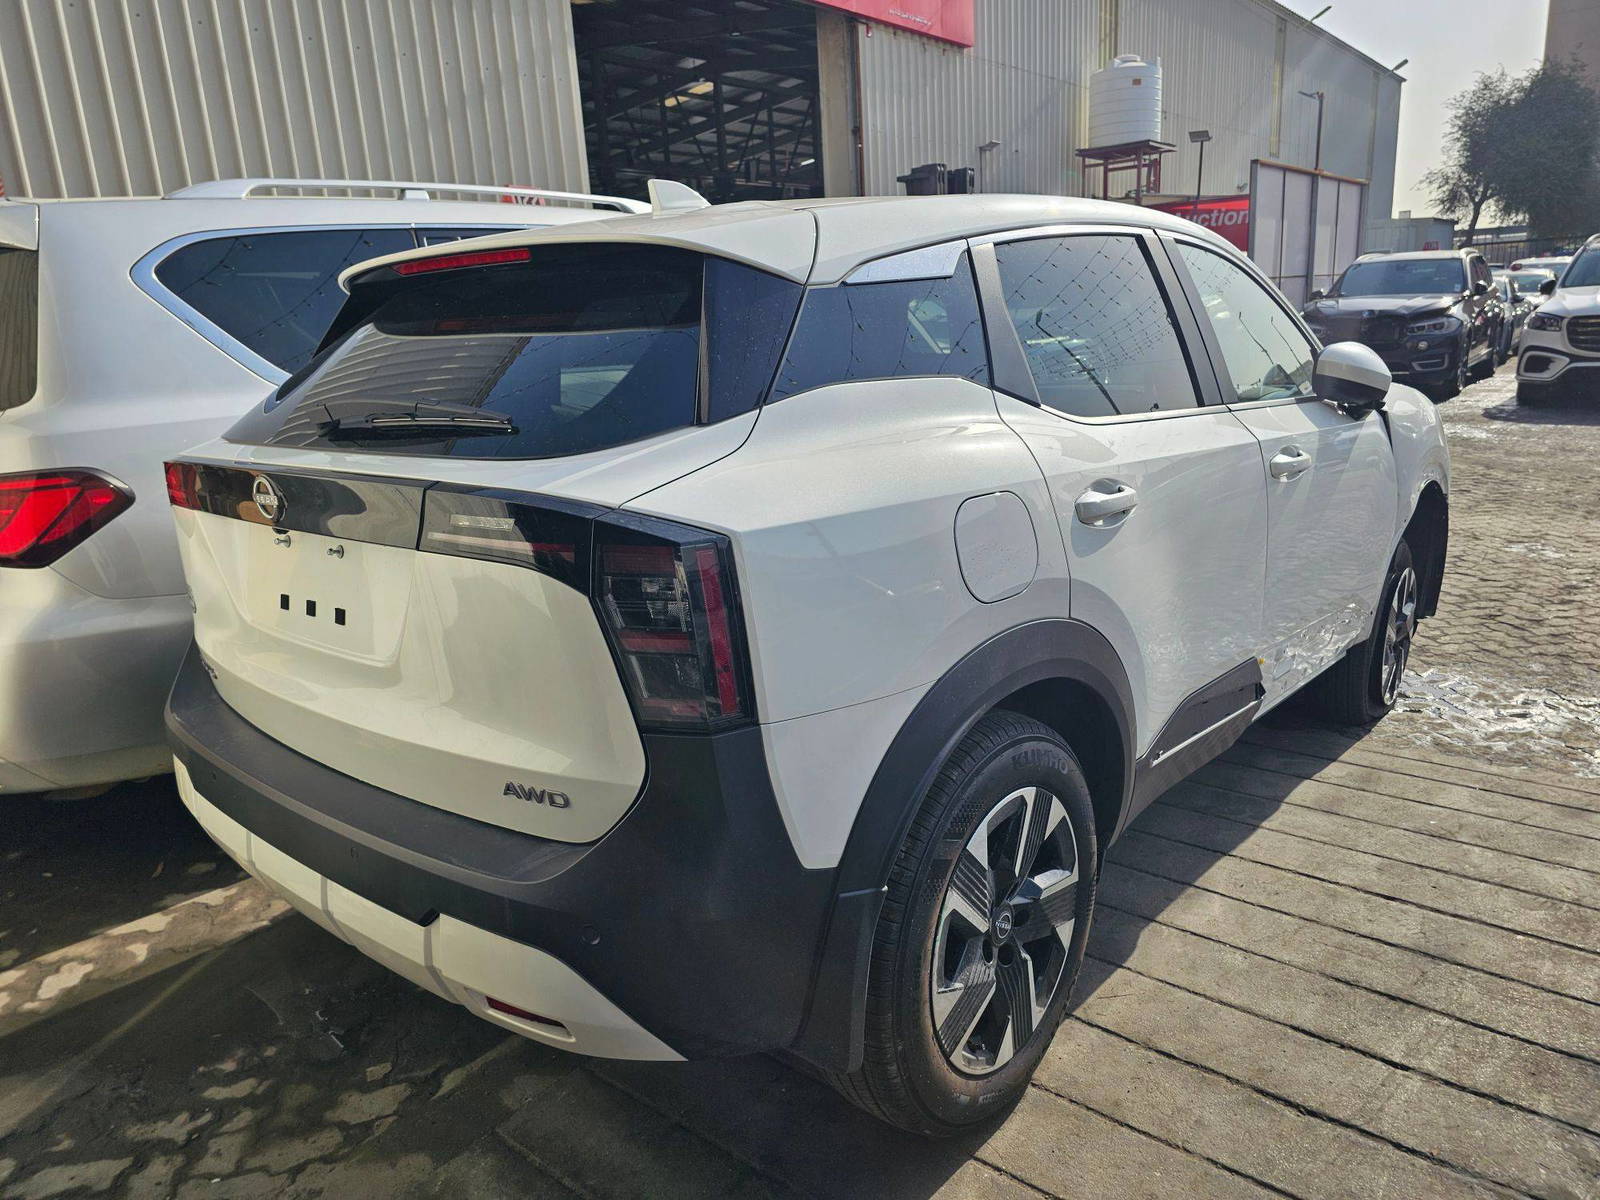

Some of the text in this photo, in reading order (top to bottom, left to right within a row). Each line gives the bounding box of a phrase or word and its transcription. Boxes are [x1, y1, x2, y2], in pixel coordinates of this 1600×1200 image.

[1175, 206, 1249, 226] ction
[1011, 747, 1068, 775] KUMHO
[503, 781, 569, 808] AWD
